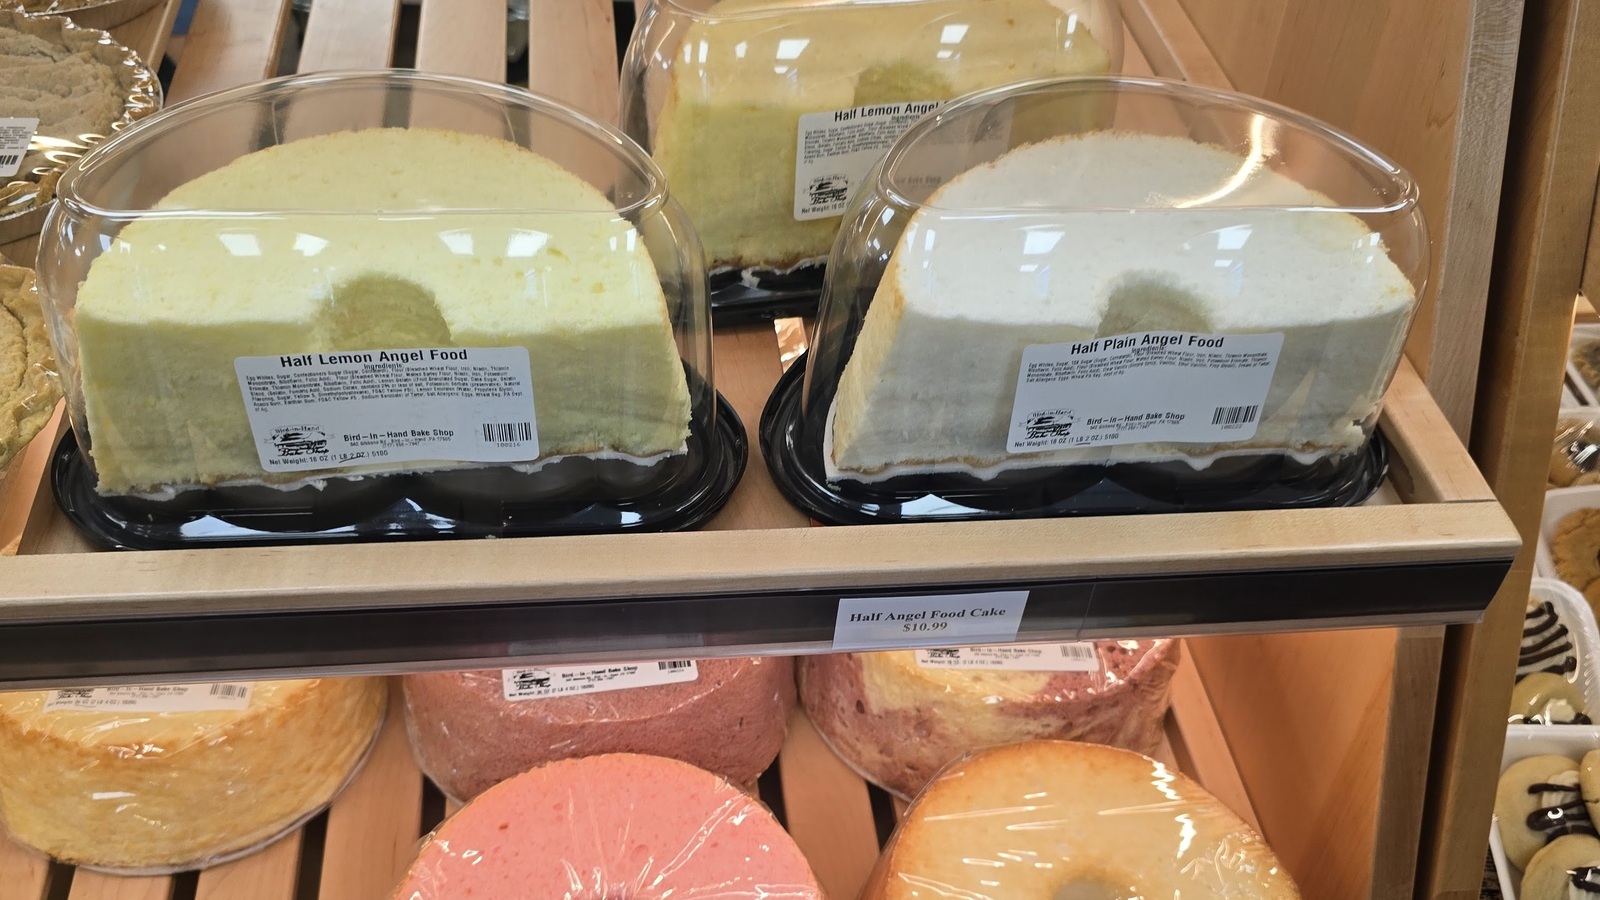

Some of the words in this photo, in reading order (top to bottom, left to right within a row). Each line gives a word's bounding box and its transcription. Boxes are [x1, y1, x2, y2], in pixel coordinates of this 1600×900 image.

[834, 109, 857, 122] Half
[861, 106, 899, 117] Lemon
[1071, 341, 1099, 355] Half
[1103, 336, 1136, 351] Plain
[1141, 334, 1183, 346] Angel
[1188, 335, 1224, 347] Food
[280, 355, 312, 367] Half
[319, 353, 372, 364] Lemon
[380, 350, 424, 363] Angel
[430, 349, 467, 360] Food
[1165, 412, 1185, 421] Shop
[433, 429, 454, 437] Shop
[850, 612, 882, 622] Half
[884, 610, 926, 622] Angel
[930, 609, 965, 619] Food
[971, 607, 1006, 617] Cake
[903, 622, 948, 632] $10.99
